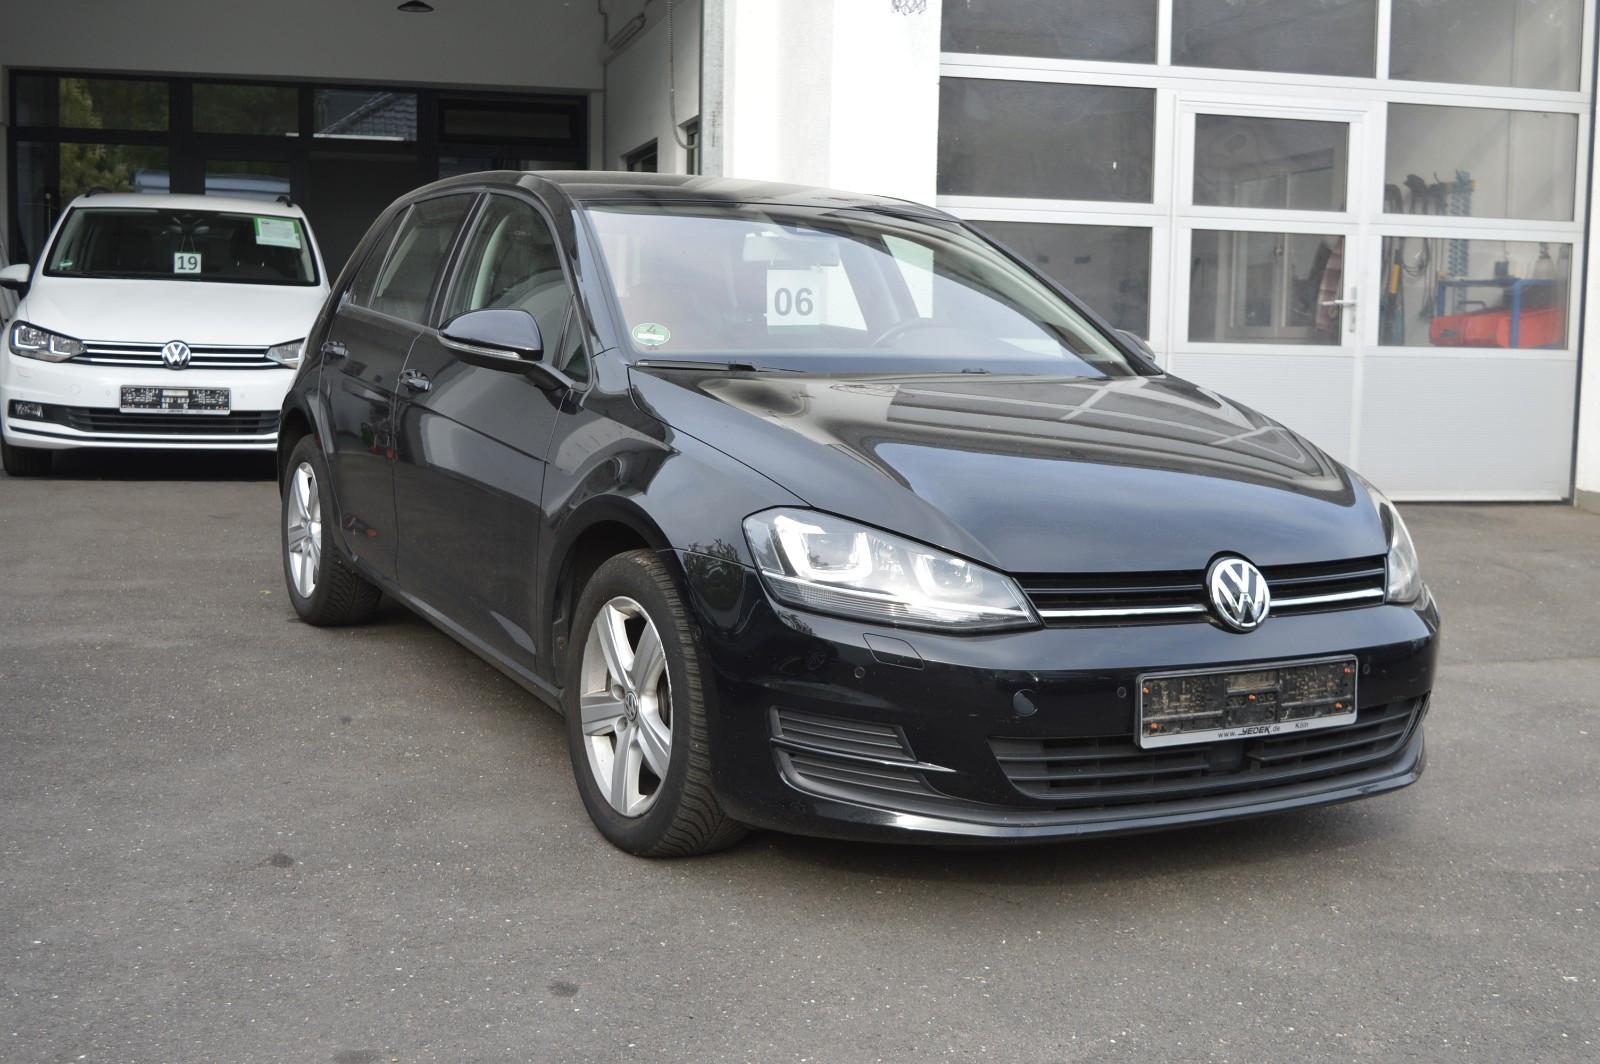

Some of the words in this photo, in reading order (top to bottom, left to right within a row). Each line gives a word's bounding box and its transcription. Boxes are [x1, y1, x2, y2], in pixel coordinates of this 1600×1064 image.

[177, 255, 198, 271] 19
[774, 287, 813, 316] 06
[161, 341, 191, 369] VW
[1211, 558, 1270, 627] VW
